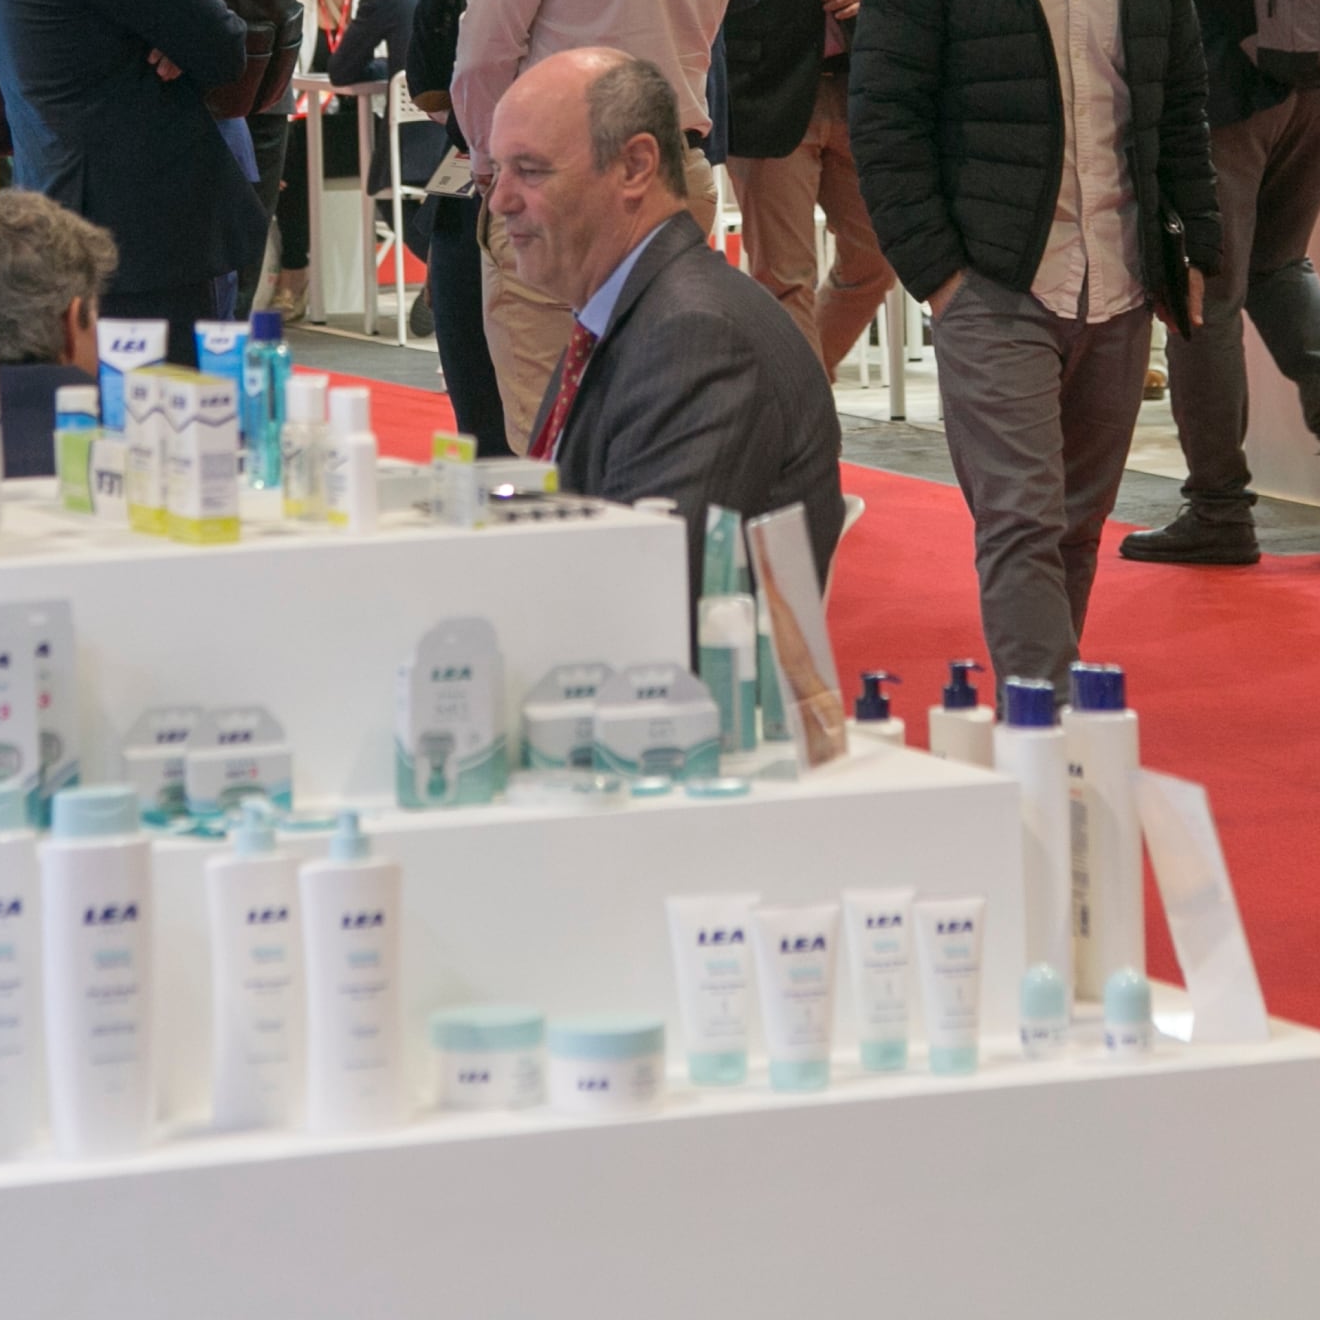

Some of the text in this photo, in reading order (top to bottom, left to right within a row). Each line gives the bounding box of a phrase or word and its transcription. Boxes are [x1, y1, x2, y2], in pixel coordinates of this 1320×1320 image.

[82, 901, 139, 927] LEA
[246, 905, 289, 925] LEA
[341, 910, 384, 931] LEA
[866, 913, 902, 930] LEA
[937, 920, 974, 935] LEA
[697, 929, 746, 947] LEA
[779, 935, 827, 955] LEA
